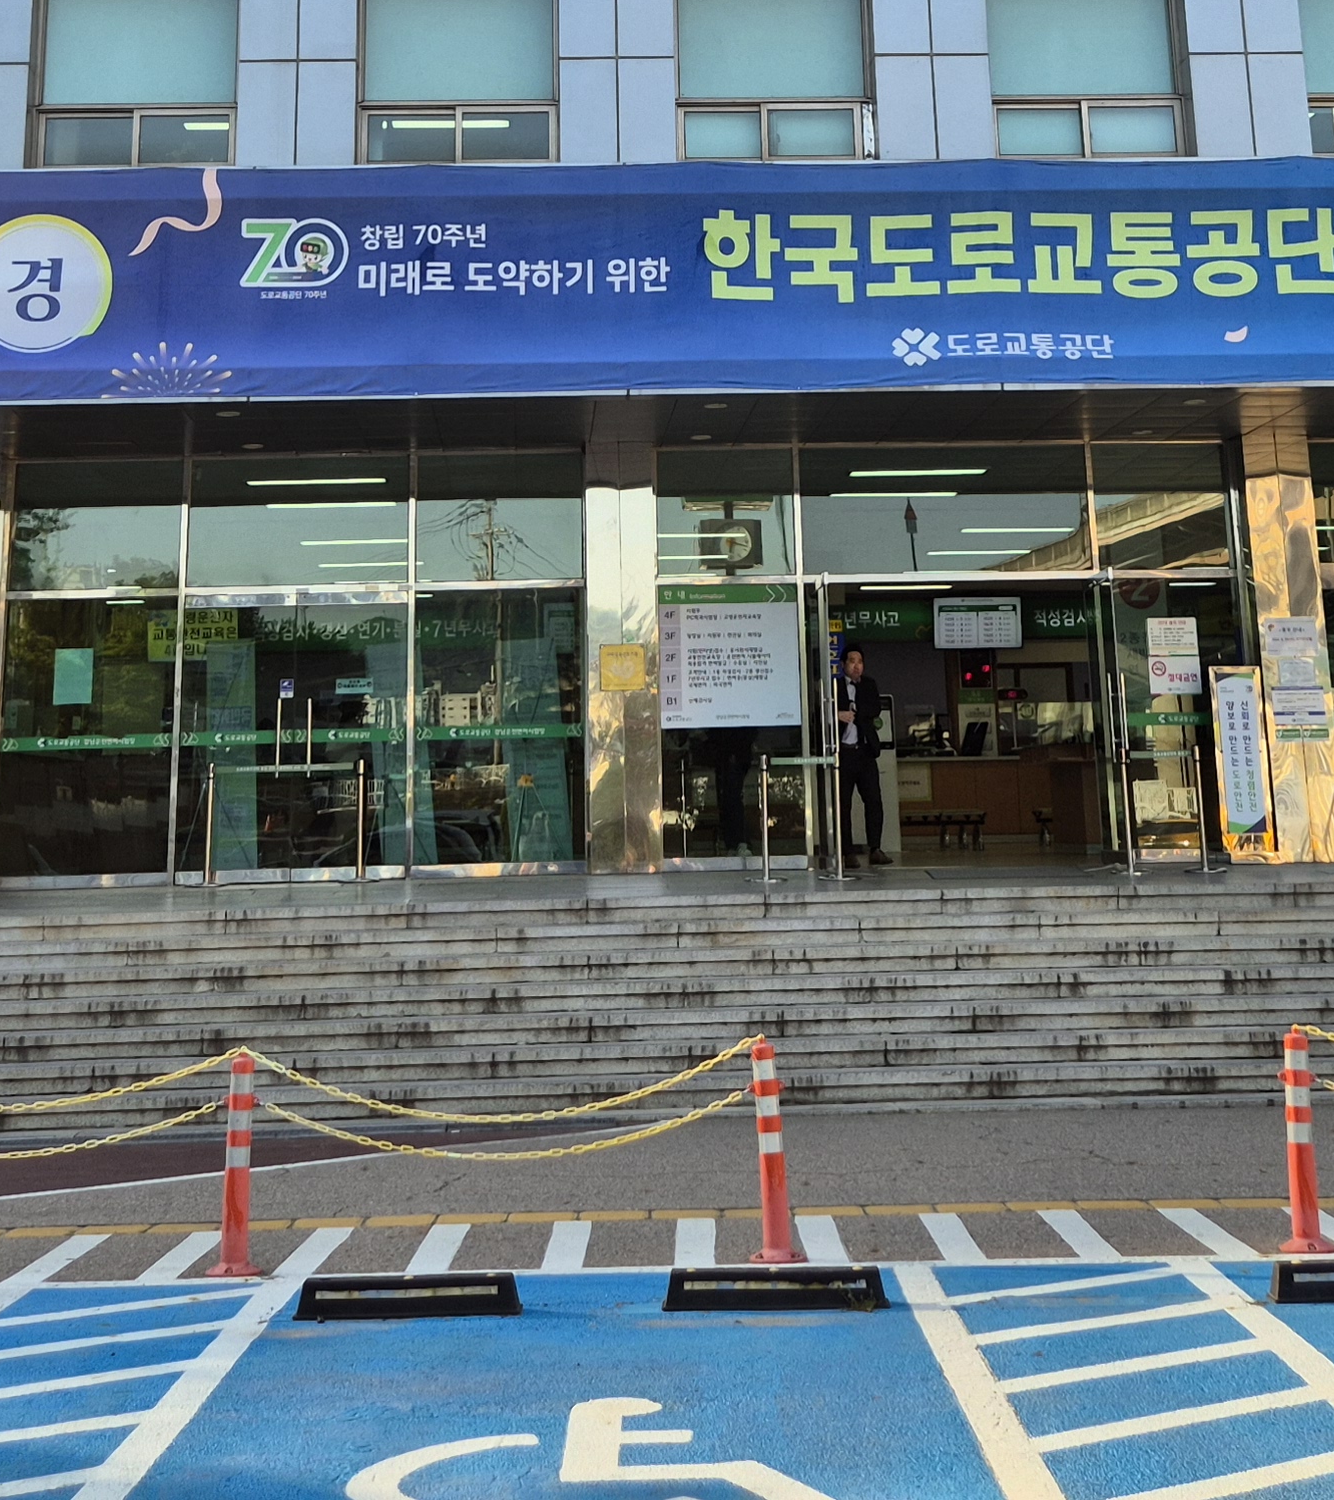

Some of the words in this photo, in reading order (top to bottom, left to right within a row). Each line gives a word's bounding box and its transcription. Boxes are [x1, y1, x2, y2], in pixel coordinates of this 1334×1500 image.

[360, 224, 404, 251] 창립
[412, 223, 487, 248] 70주년
[7, 258, 63, 323] 경
[358, 259, 455, 297] 미래로
[464, 258, 594, 296] 도약하기
[606, 257, 671, 293] 위한
[946, 332, 1115, 360] 도로교통공단
